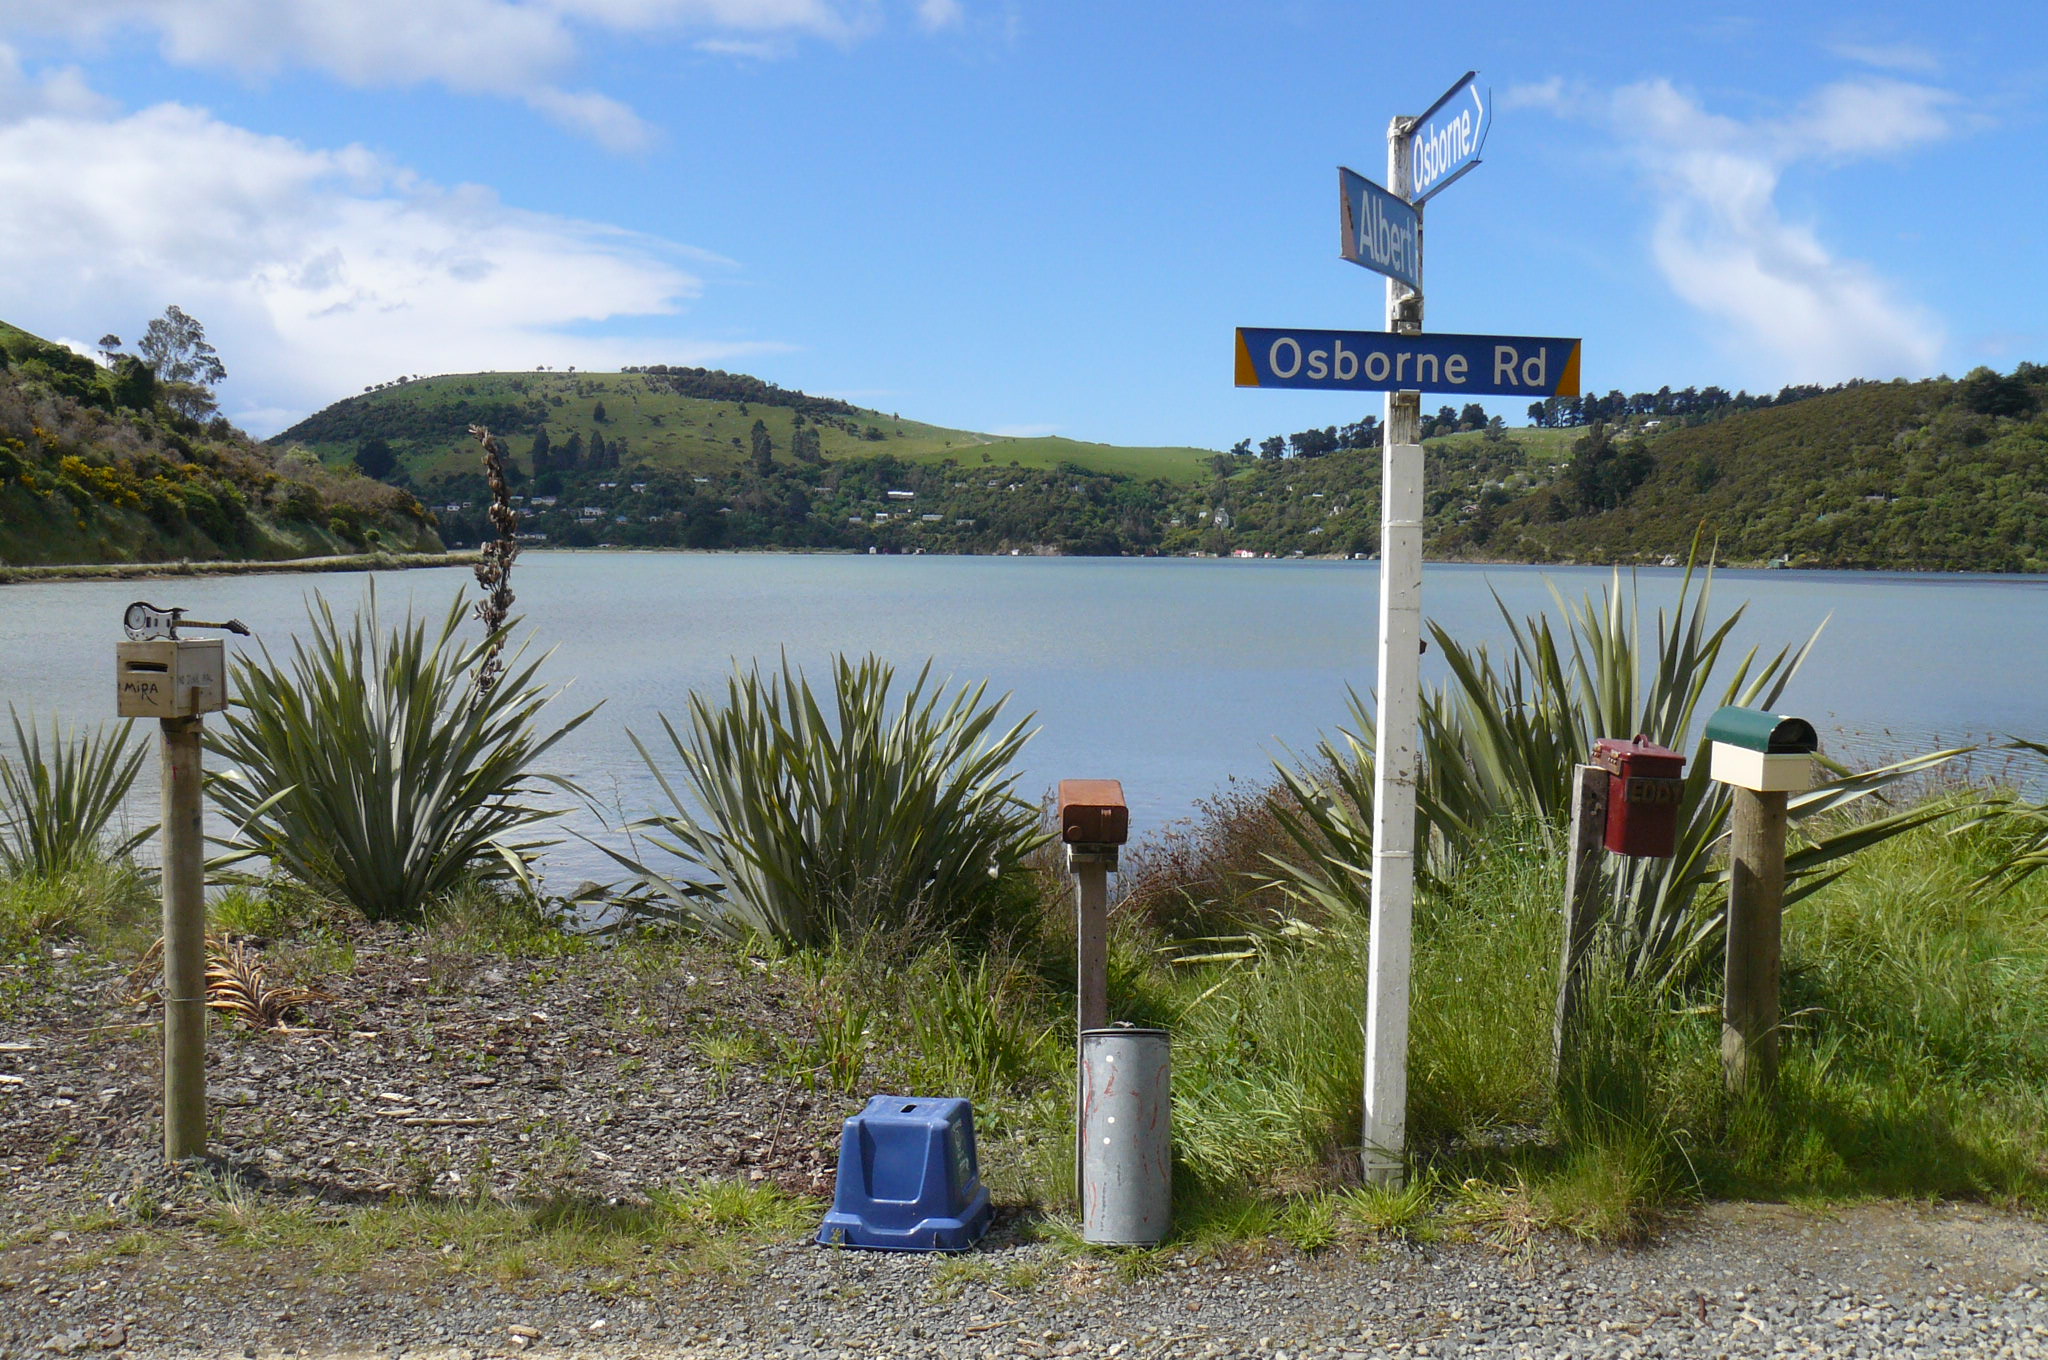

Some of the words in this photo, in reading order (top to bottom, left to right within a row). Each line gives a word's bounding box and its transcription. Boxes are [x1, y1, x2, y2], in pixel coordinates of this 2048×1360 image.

[1412, 108, 1470, 194] Osborne
[1360, 190, 1413, 278] Albert
[1269, 337, 1468, 385] Osborne
[1493, 345, 1546, 387] Rd
